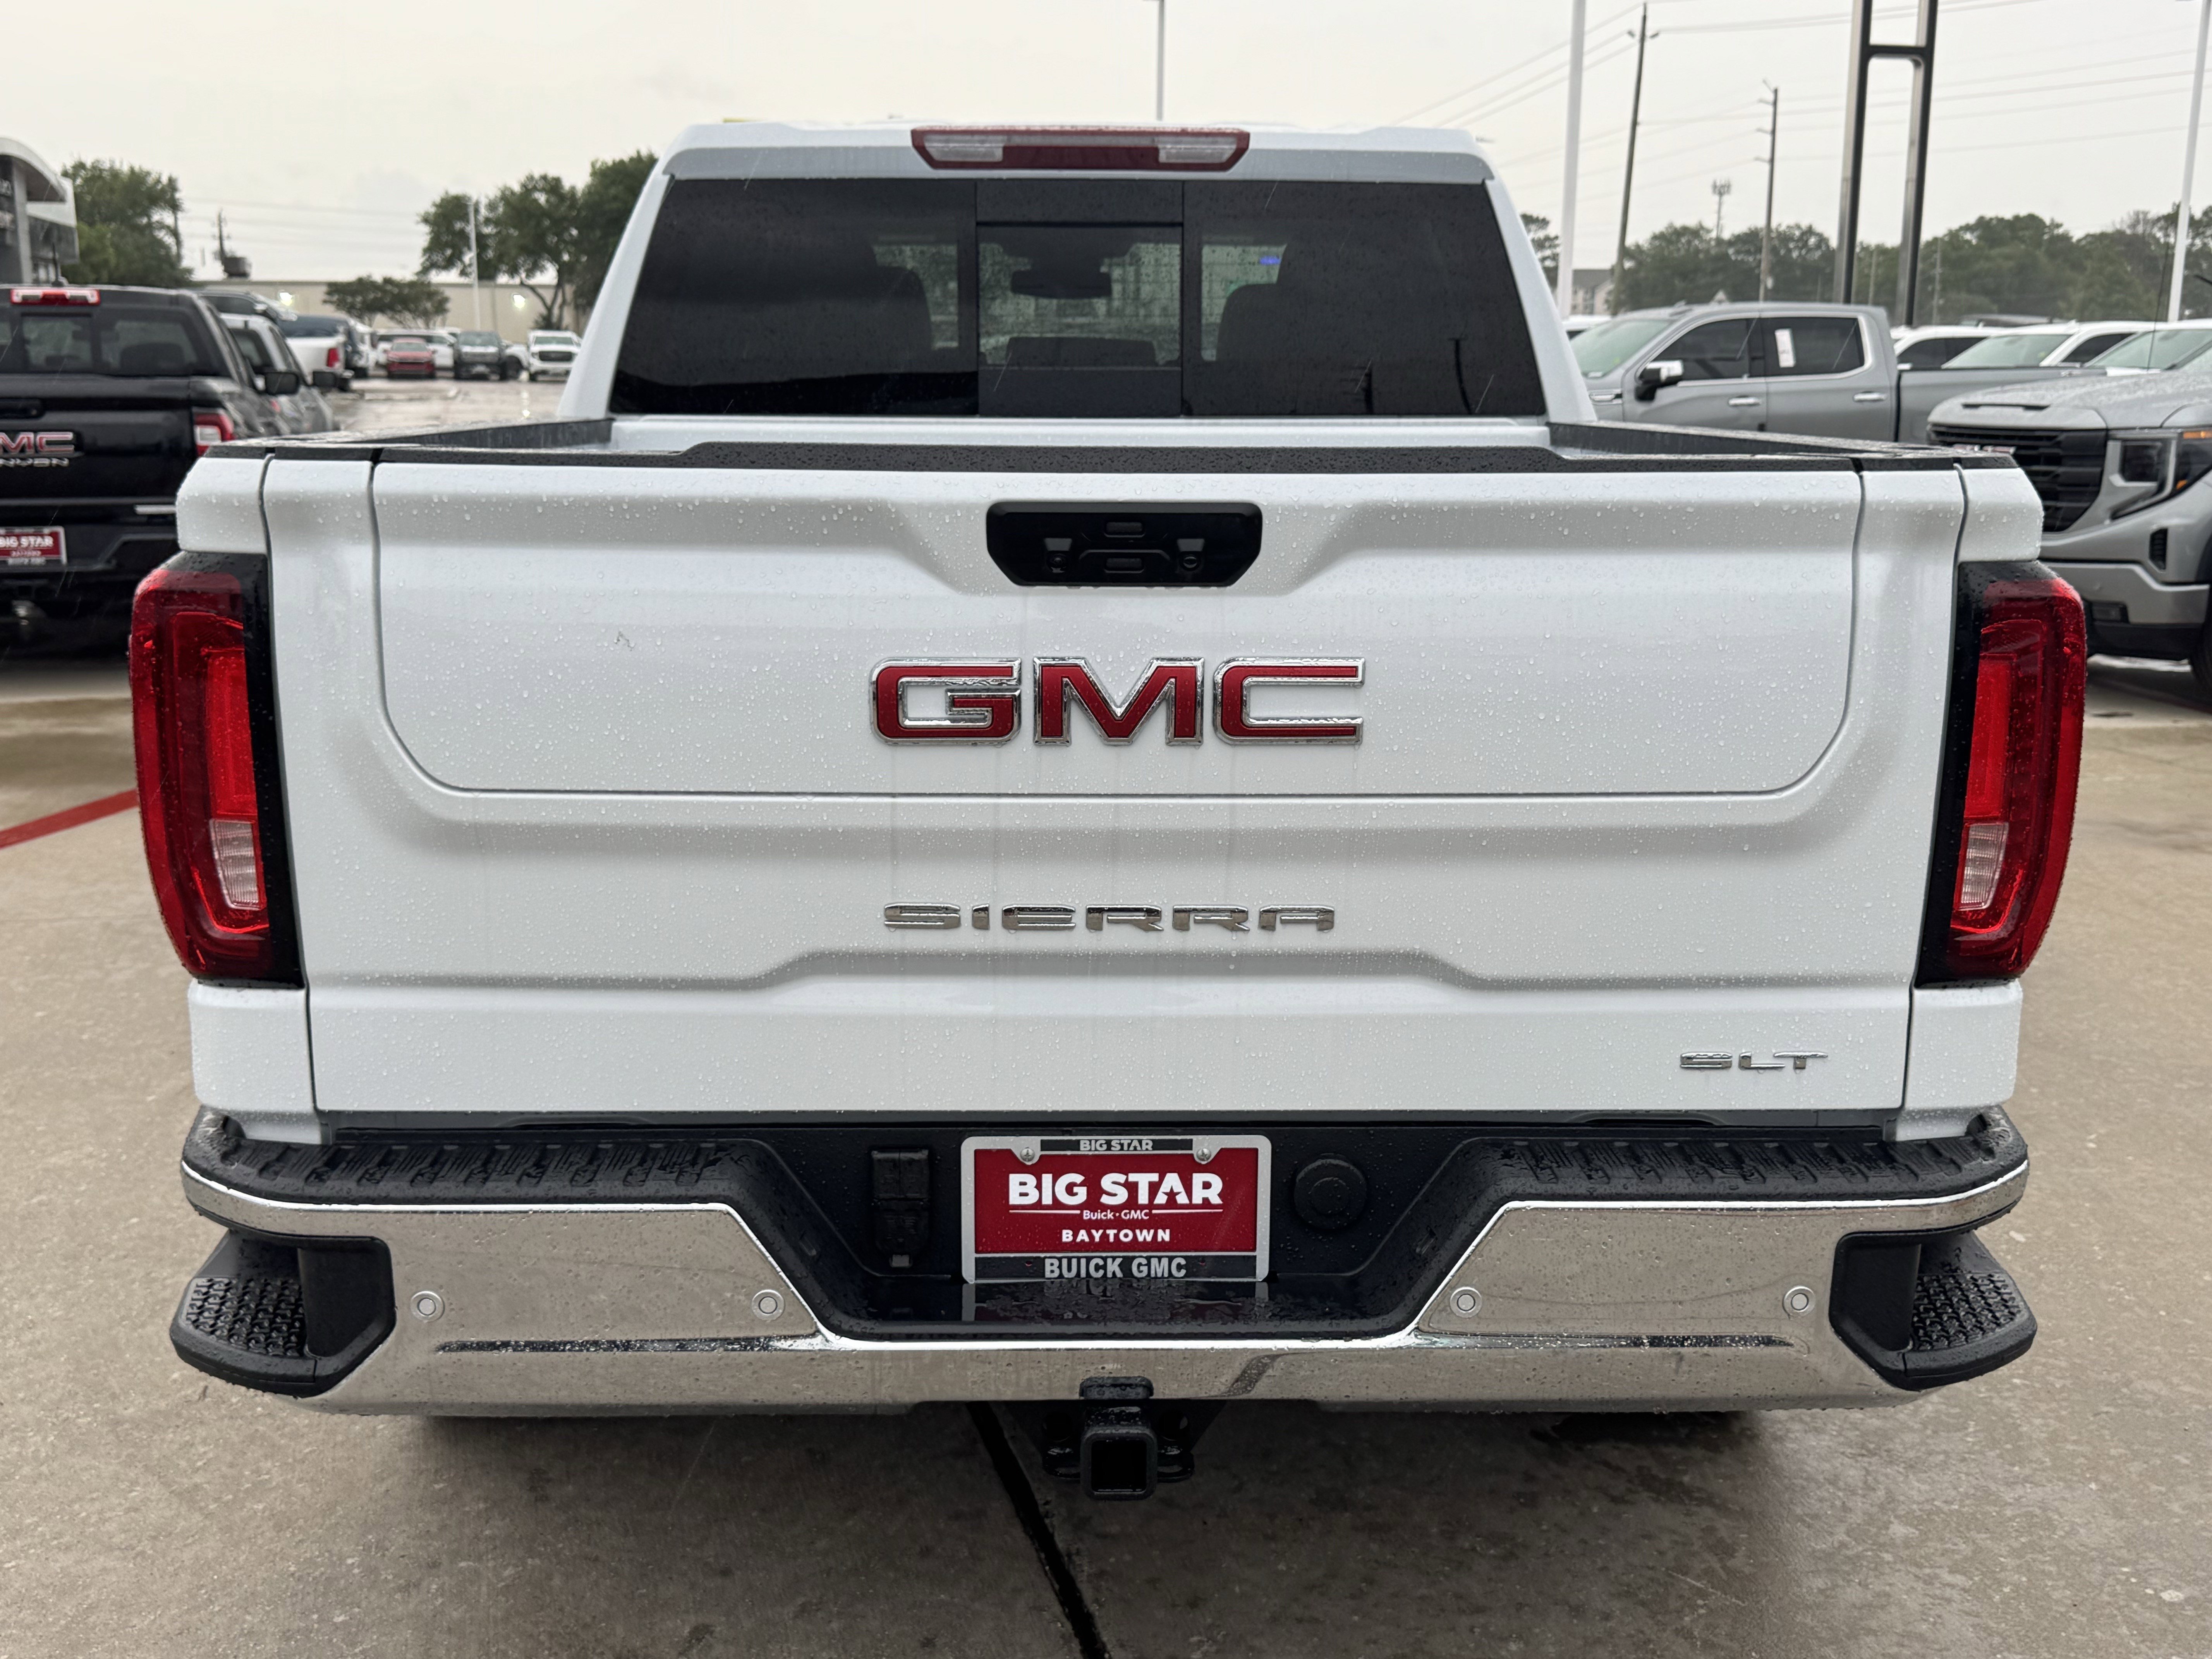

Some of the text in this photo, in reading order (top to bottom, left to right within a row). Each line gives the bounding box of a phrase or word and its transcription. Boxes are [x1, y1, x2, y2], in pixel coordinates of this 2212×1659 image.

[0, 431, 75, 454] MC
[0, 458, 69, 467] NYON
[20, 536, 53, 548] STAR
[869, 657, 1366, 746] GMC
[884, 904, 1335, 931] SIERRA
[1680, 1051, 1828, 1070] SLT
[1079, 1139, 1153, 1151] BIG STAR
[1009, 1173, 1223, 1205] BIG STAR
[1083, 1209, 1149, 1220] Buick GMC
[1061, 1229, 1170, 1242] BAYTOWN
[1044, 1257, 1187, 1278] BUICK GMC
